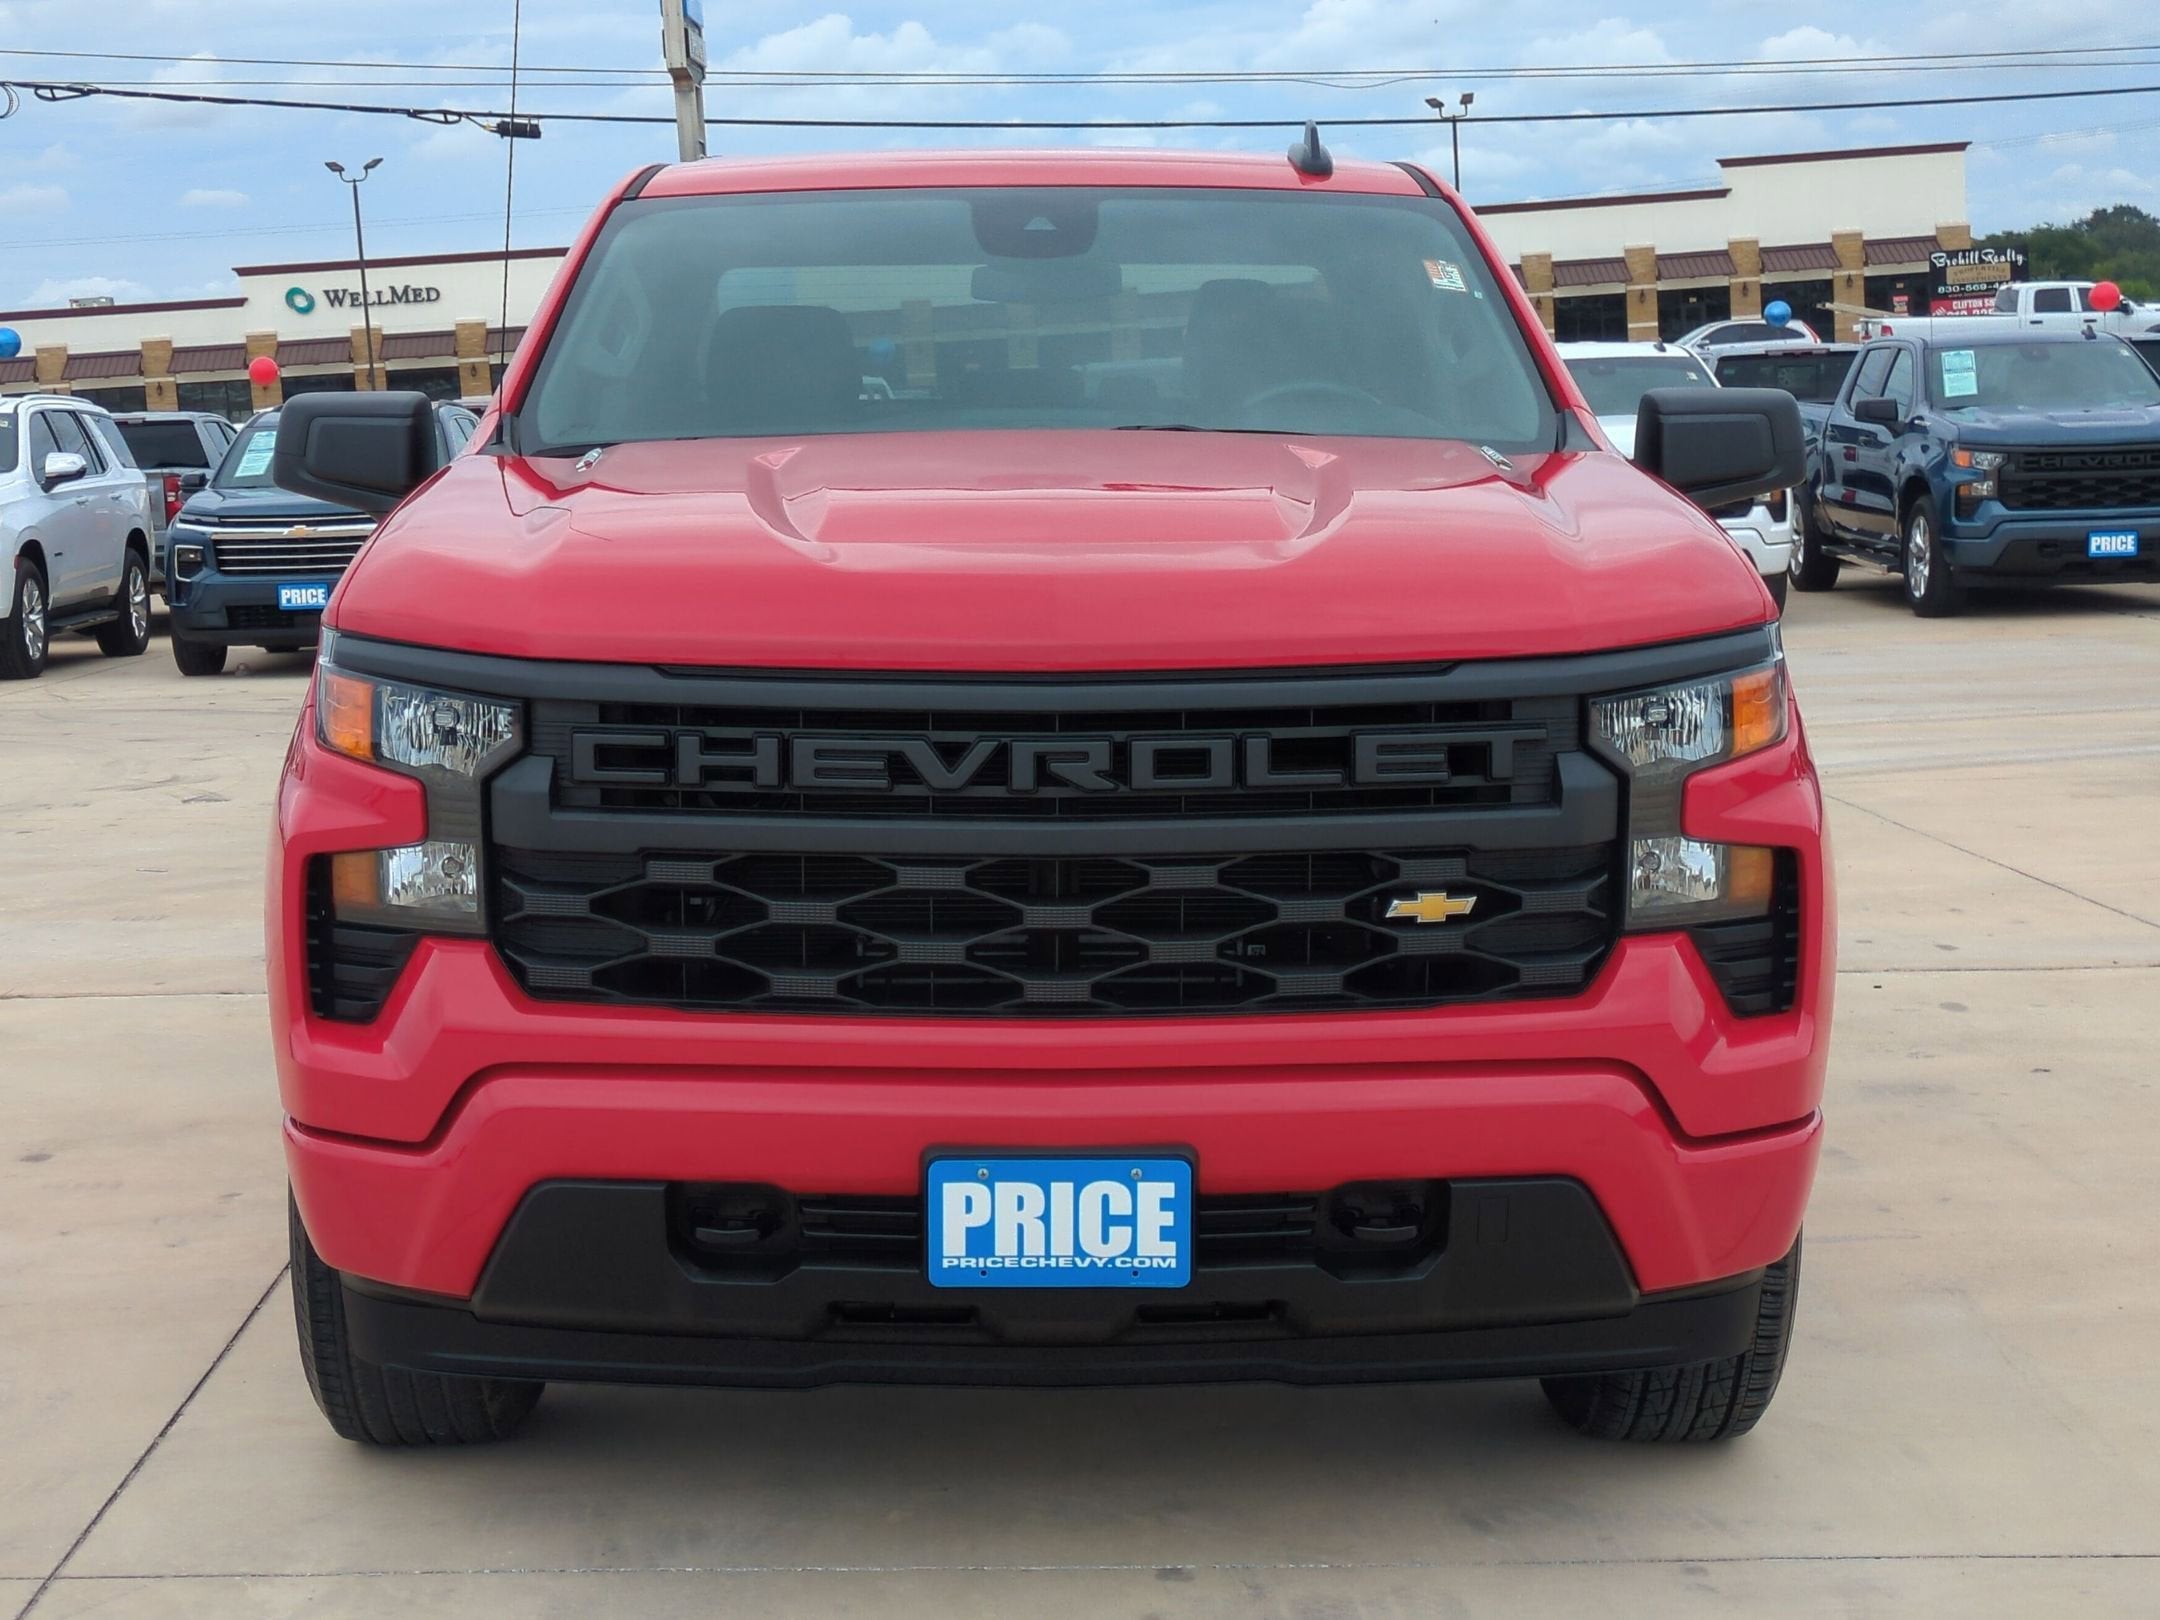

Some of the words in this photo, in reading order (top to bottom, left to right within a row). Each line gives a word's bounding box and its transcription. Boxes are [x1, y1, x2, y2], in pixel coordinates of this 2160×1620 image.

[2091, 535, 2135, 552] PRICE
[281, 588, 326, 605] PRICE
[571, 727, 1548, 791] CHEVROLET
[942, 1180, 1177, 1258] PRICE
[942, 1257, 1177, 1269] PRICECHEVY.COM
